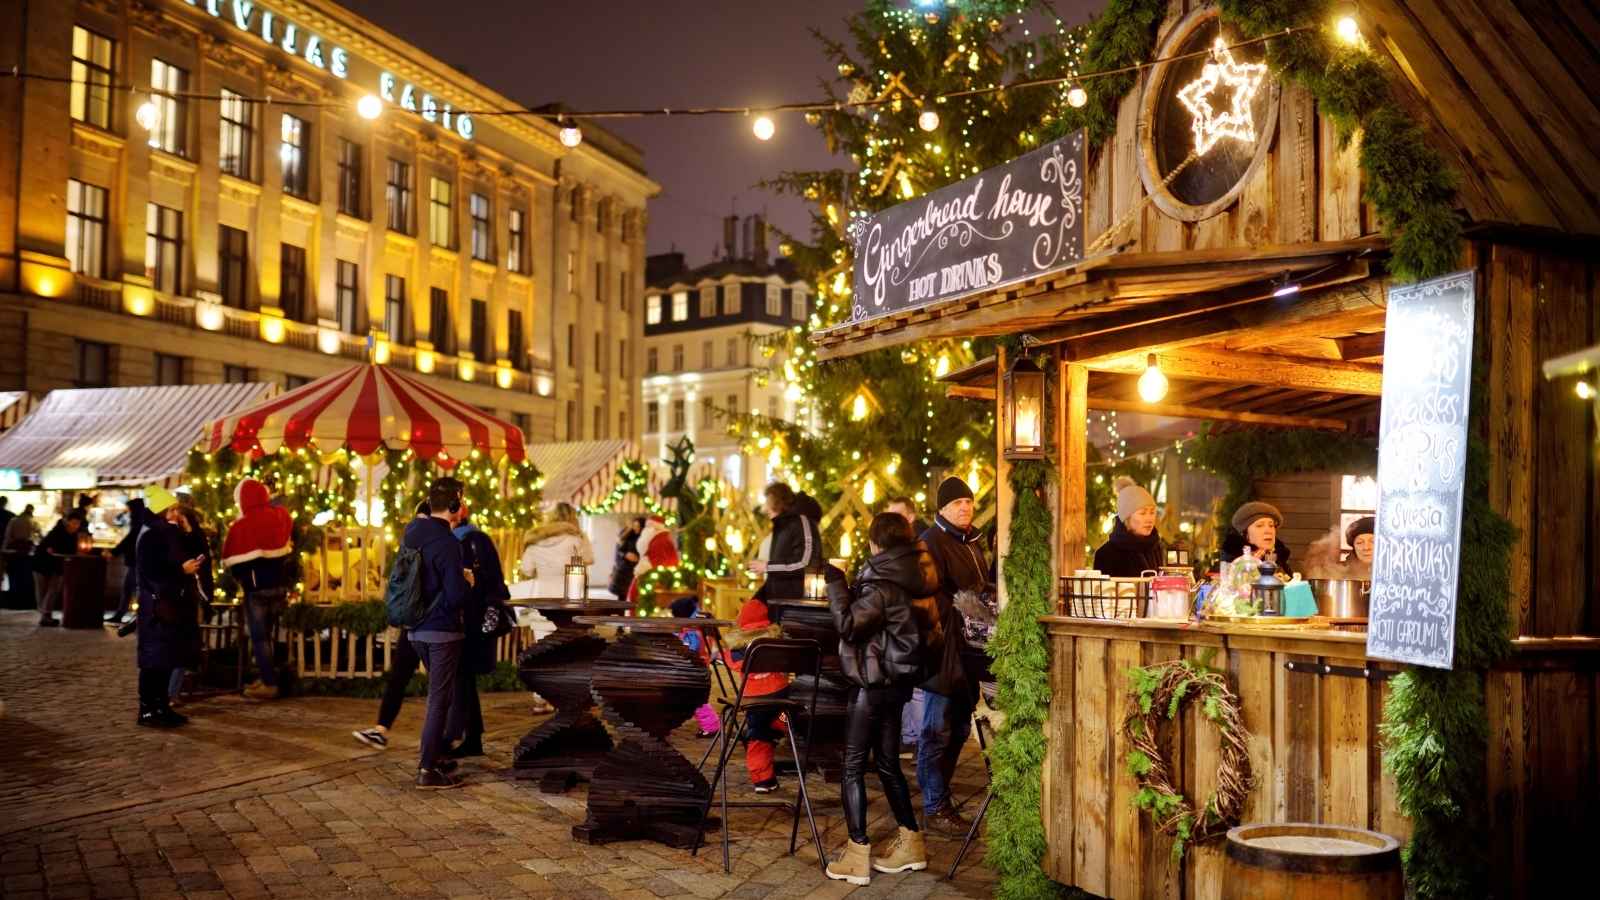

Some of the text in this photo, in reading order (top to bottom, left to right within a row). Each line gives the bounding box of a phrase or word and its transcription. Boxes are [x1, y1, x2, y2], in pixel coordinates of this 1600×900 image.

[184, 0, 474, 140] TVIJAS RADIO
[863, 173, 1058, 306] Gingerbread house
[908, 252, 1003, 302] HOT DRINKS
